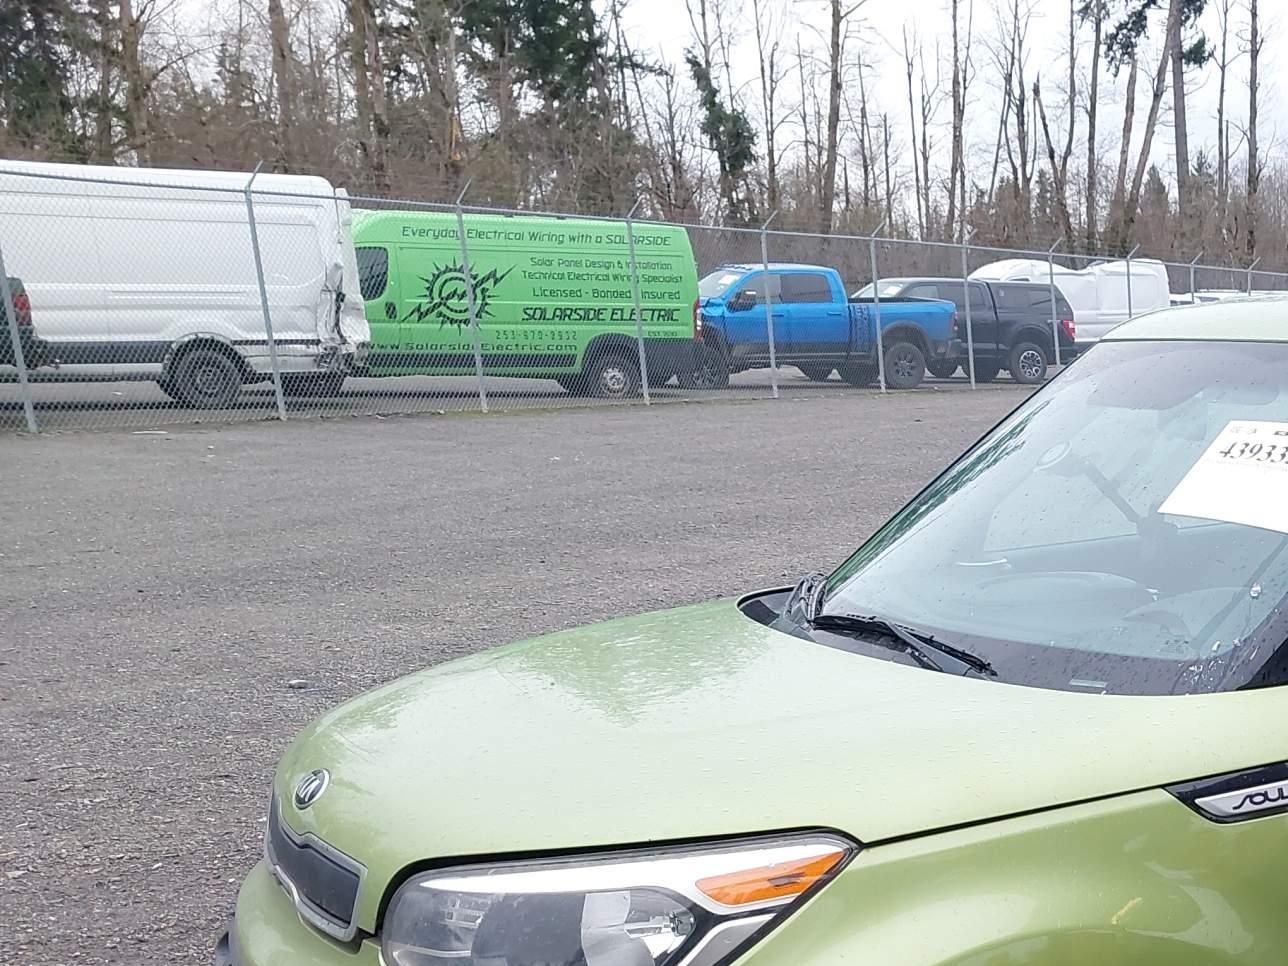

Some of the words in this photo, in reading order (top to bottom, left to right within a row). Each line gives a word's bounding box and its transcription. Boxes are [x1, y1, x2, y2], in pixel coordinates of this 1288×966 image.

[467, 228, 524, 241] Electrical
[529, 231, 564, 245] Wiring
[568, 232, 592, 243] with
[595, 235, 602, 243] a
[530, 257, 553, 267] Solar
[558, 258, 582, 268] Panel
[585, 259, 615, 270] Design
[522, 270, 565, 280] Technical
[567, 271, 609, 281] Electrical
[642, 274, 683, 284] Specialist
[533, 287, 582, 298] Licensed
[592, 288, 632, 299] Bonded
[641, 290, 680, 300] Insured
[522, 307, 608, 321] SOLARSIDE
[610, 308, 681, 322] ELECTRIC
